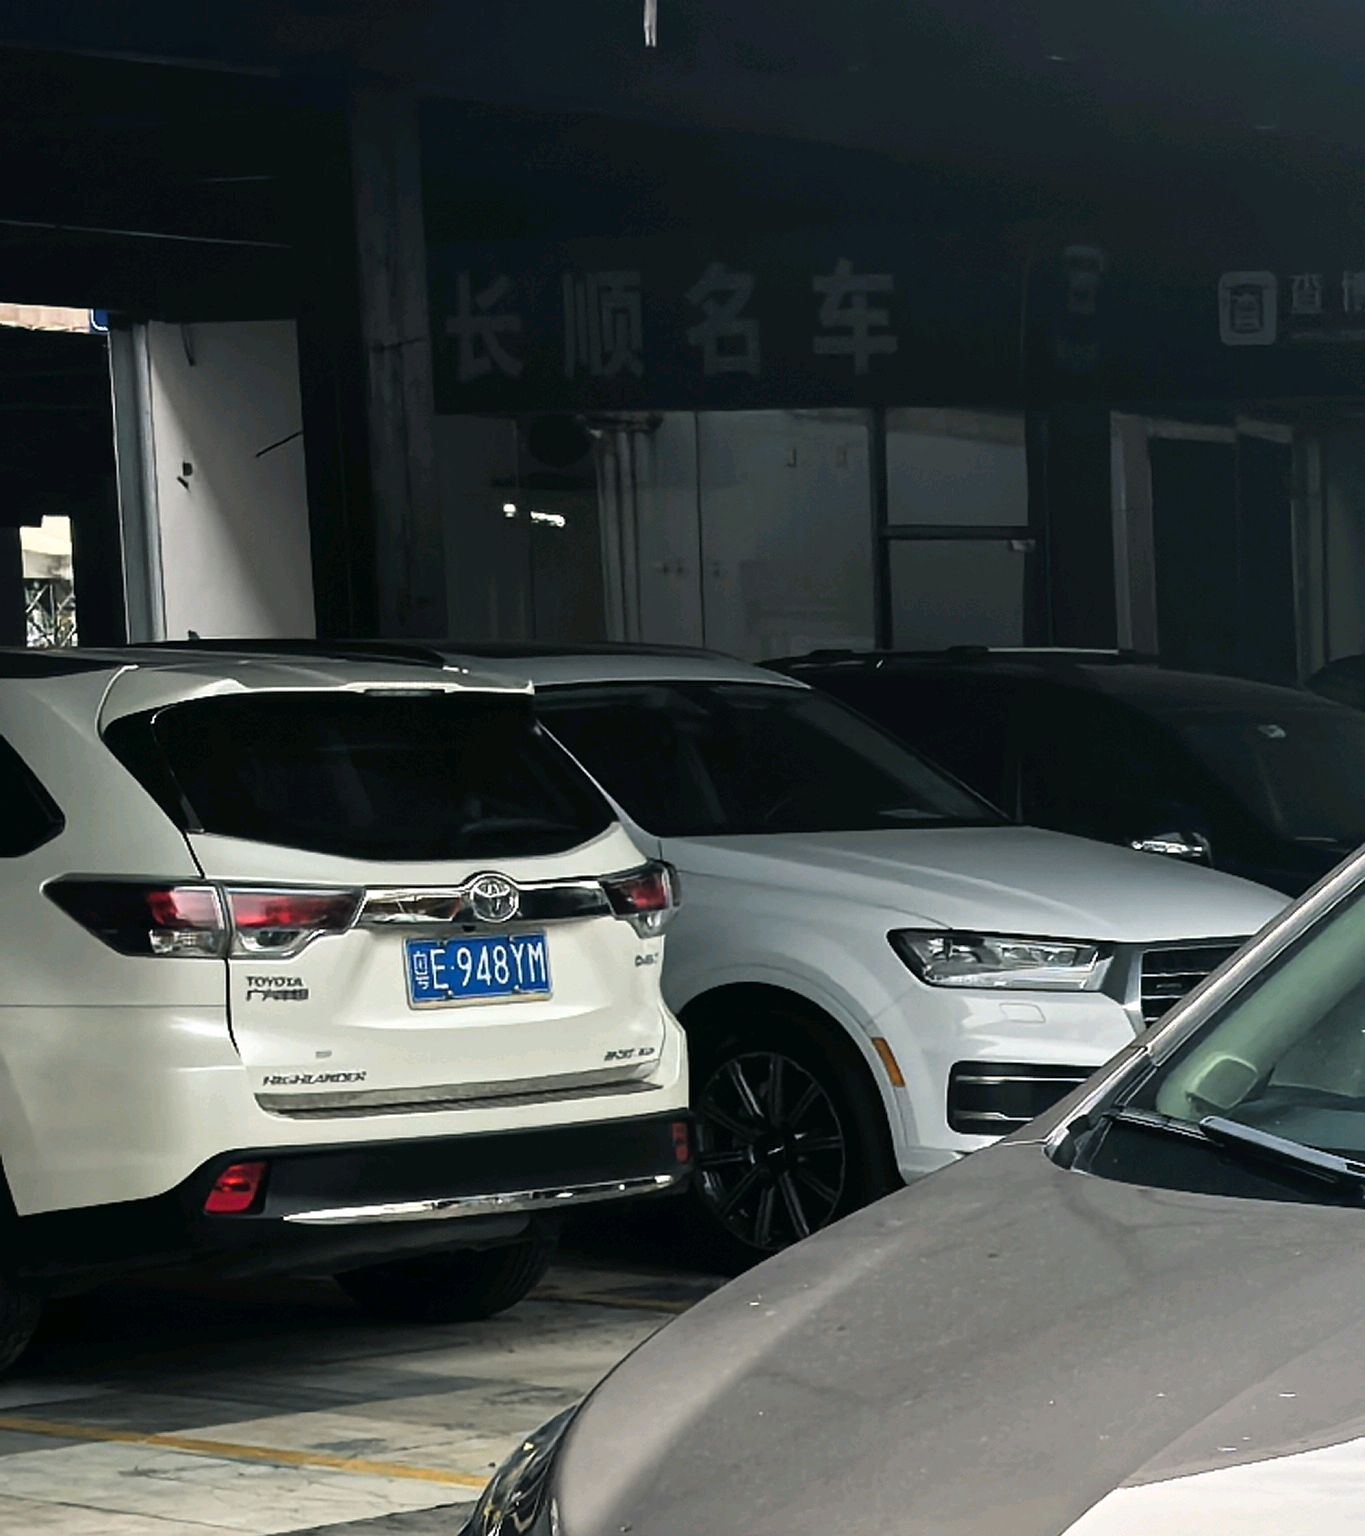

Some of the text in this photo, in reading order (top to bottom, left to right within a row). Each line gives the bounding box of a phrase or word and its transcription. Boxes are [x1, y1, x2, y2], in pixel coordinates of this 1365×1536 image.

[445, 258, 900, 382] 长顺名车
[246, 976, 304, 988] TOYOTA
[263, 1071, 367, 1086] HIGHLANDER
